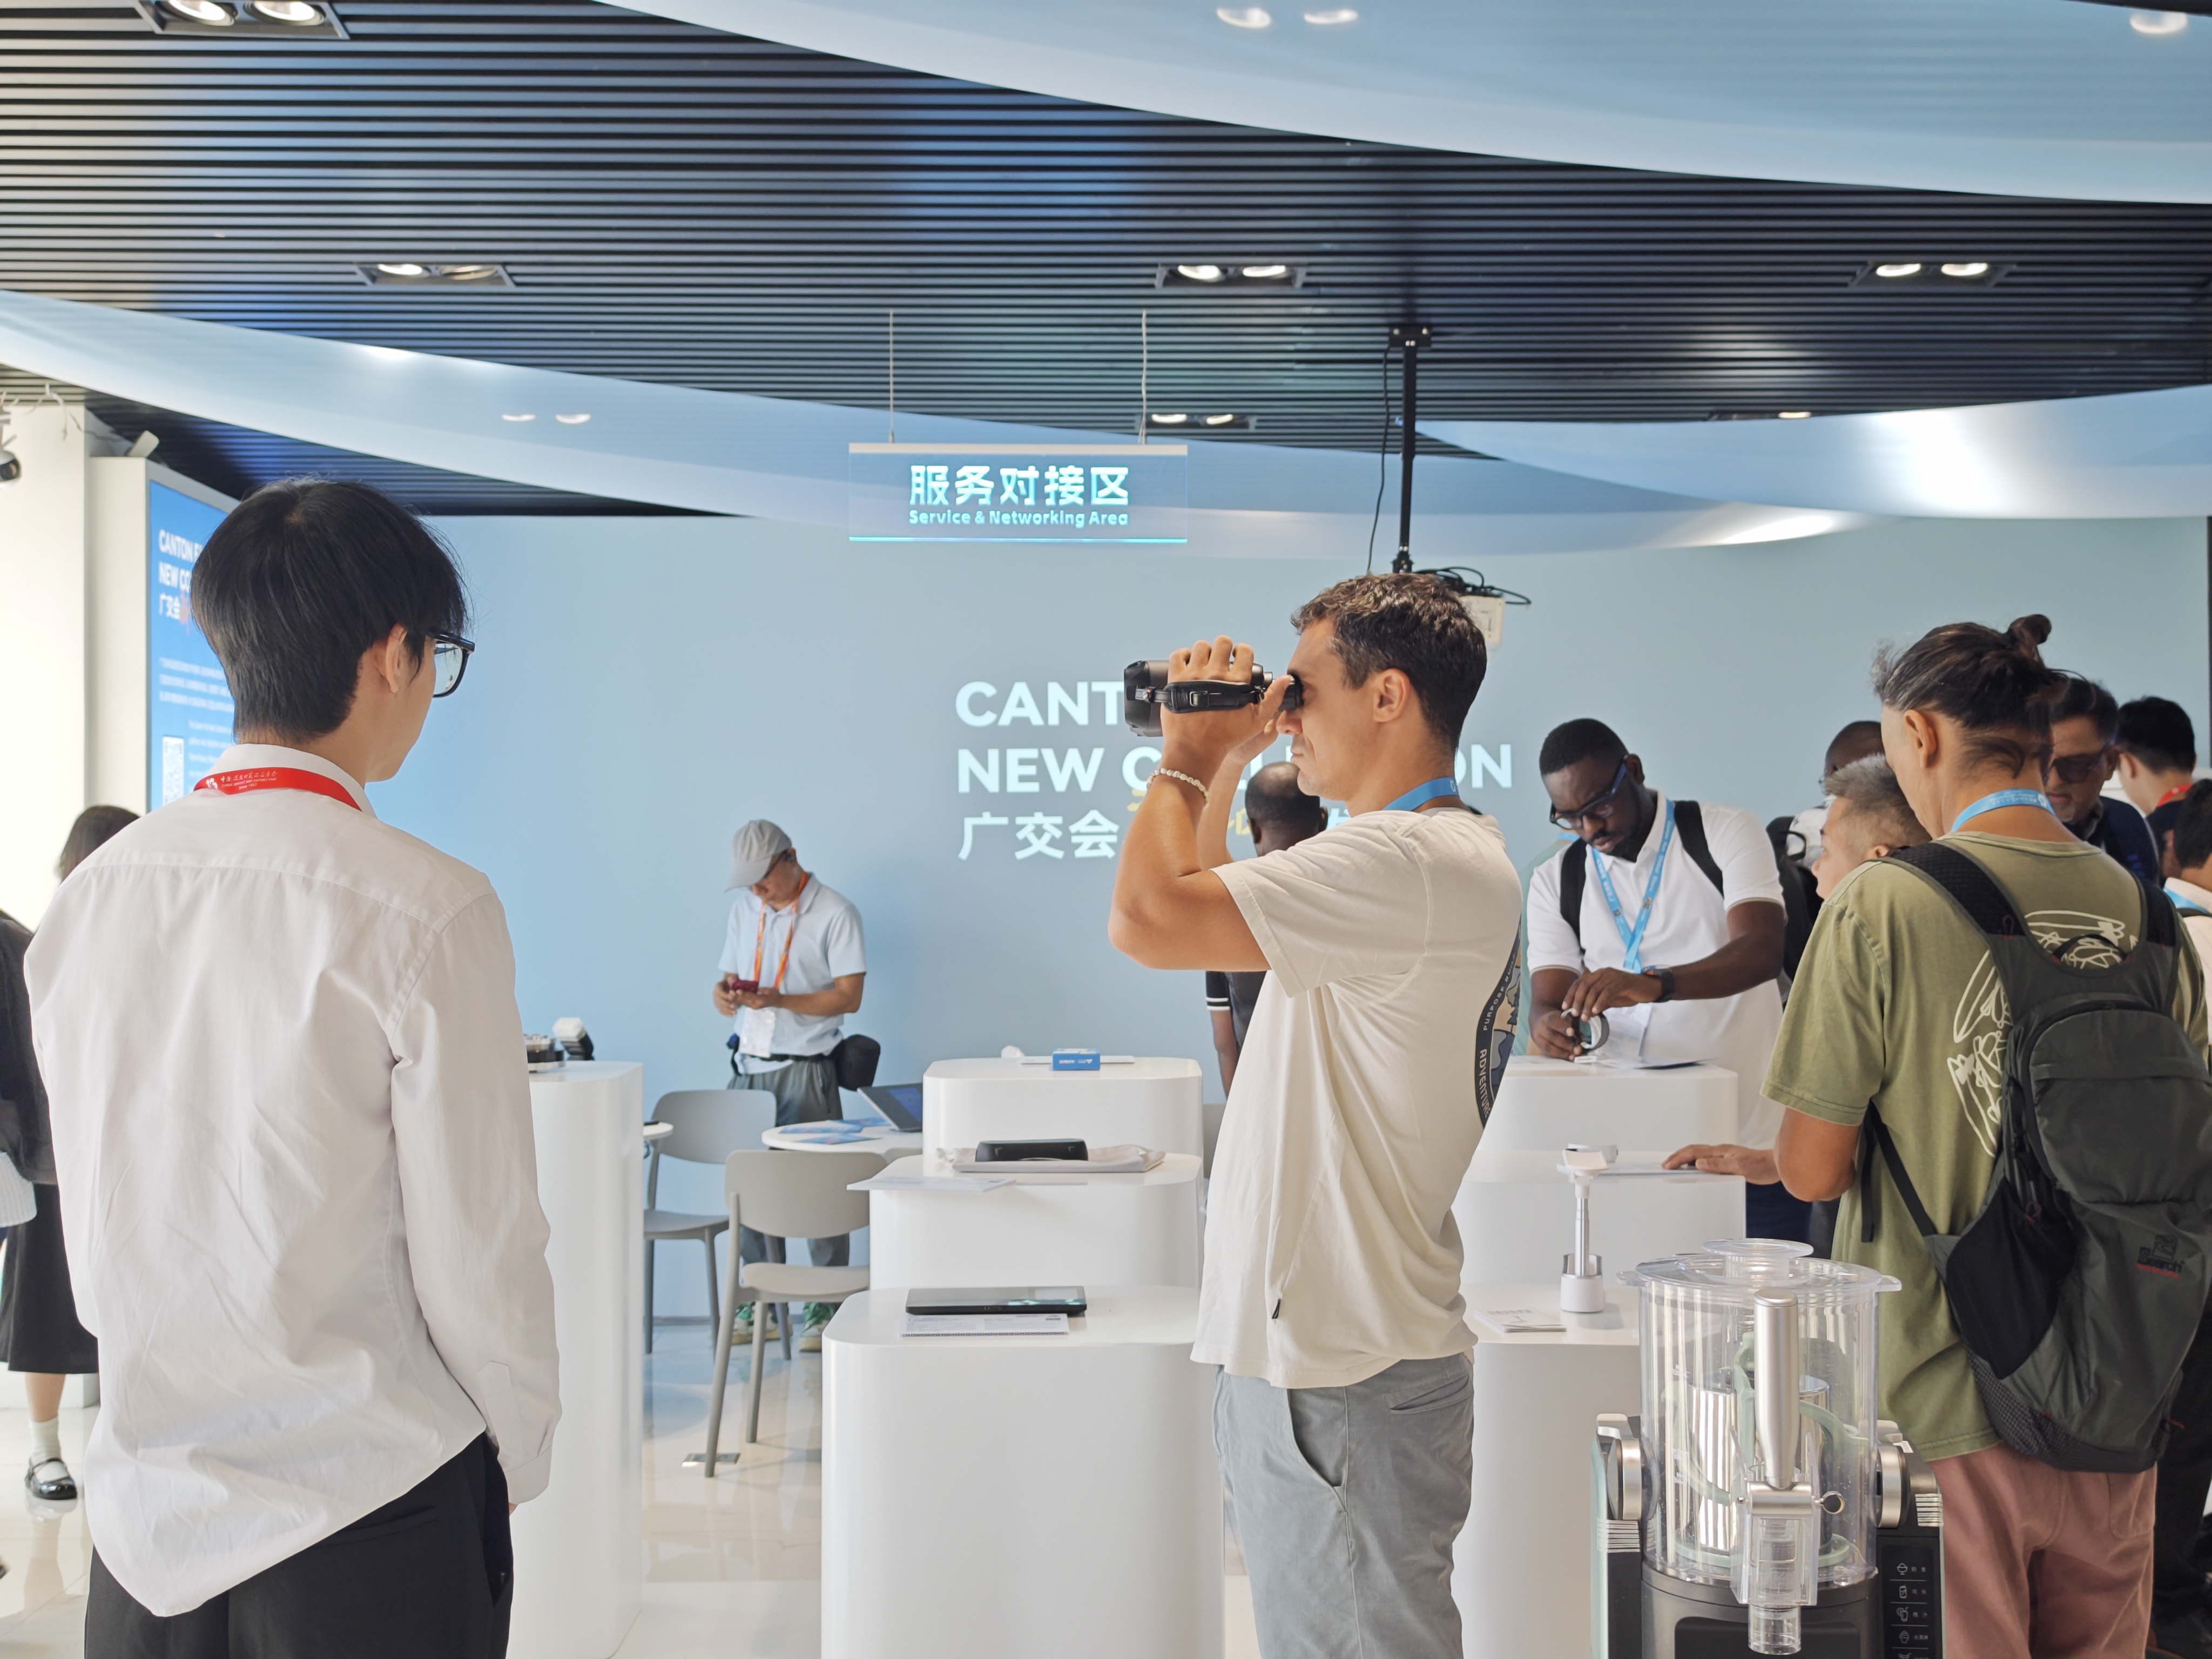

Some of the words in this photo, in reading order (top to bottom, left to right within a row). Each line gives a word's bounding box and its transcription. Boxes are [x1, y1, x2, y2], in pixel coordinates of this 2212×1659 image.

[909, 465, 1129, 507] 服务对接区
[909, 510, 970, 525] Service
[975, 511, 986, 524] &
[989, 510, 1085, 528] Networking
[1089, 511, 1129, 525] Area
[159, 529, 193, 563] CANTON
[159, 561, 179, 589] NEW
[955, 680, 1124, 727] CANT
[957, 747, 1105, 793] NEW
[1479, 1049, 1492, 1118] ADVENTURE
